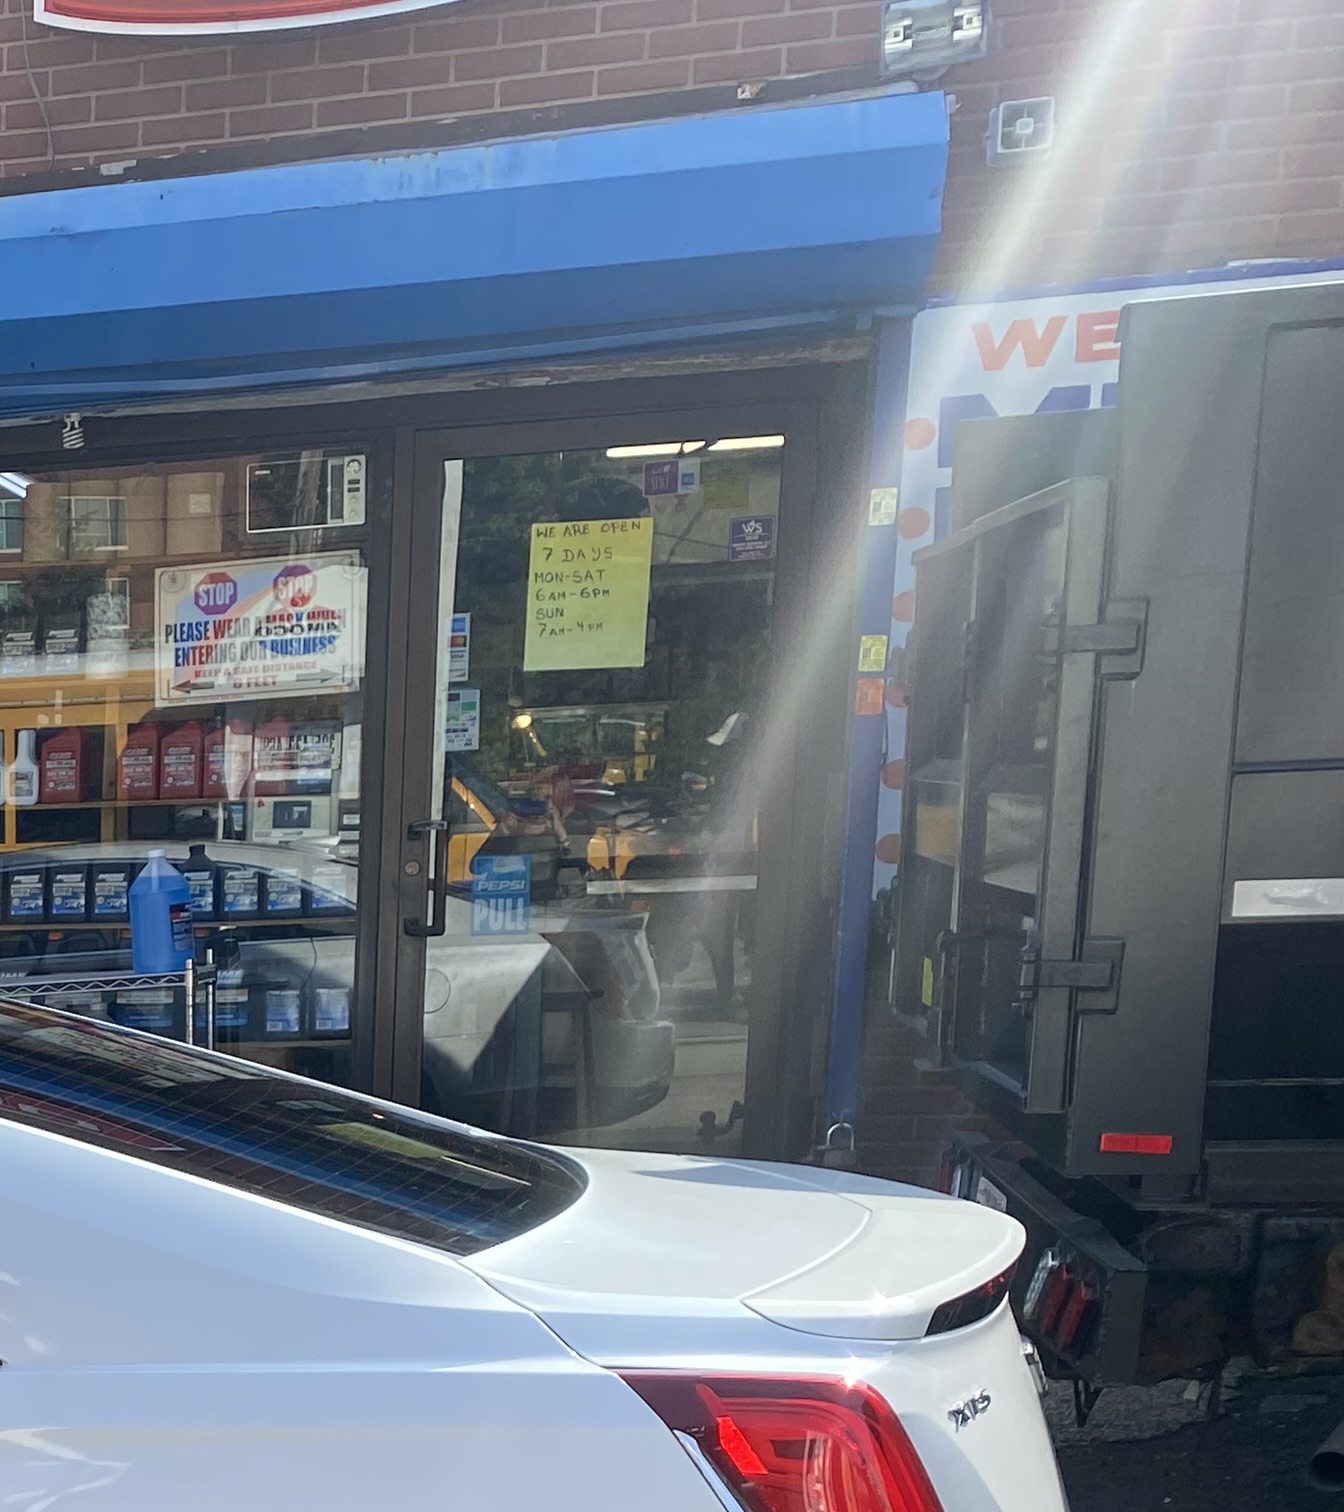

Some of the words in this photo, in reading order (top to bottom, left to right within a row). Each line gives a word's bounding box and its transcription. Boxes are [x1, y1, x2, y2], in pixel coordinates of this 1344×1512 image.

[536, 527, 556, 539] WE
[563, 524, 590, 538] ARE
[600, 520, 641, 534] OPEN
[542, 547, 553, 562] 7
[561, 546, 613, 563] DAYS
[198, 581, 235, 607] STOP
[277, 573, 313, 598] STOP
[535, 607, 565, 621] SUN
[165, 620, 211, 644] PLEASE
[213, 617, 254, 639] WEAR
[174, 641, 238, 668] ENTERING
[240, 639, 268, 661] OUR
[270, 635, 337, 658] BUSINESS
[233, 665, 260, 677] SAFE
[262, 660, 318, 673] DISTANCE
[245, 675, 278, 688] FEET
[478, 879, 526, 891] PEPSI
[473, 897, 528, 932] PULL
